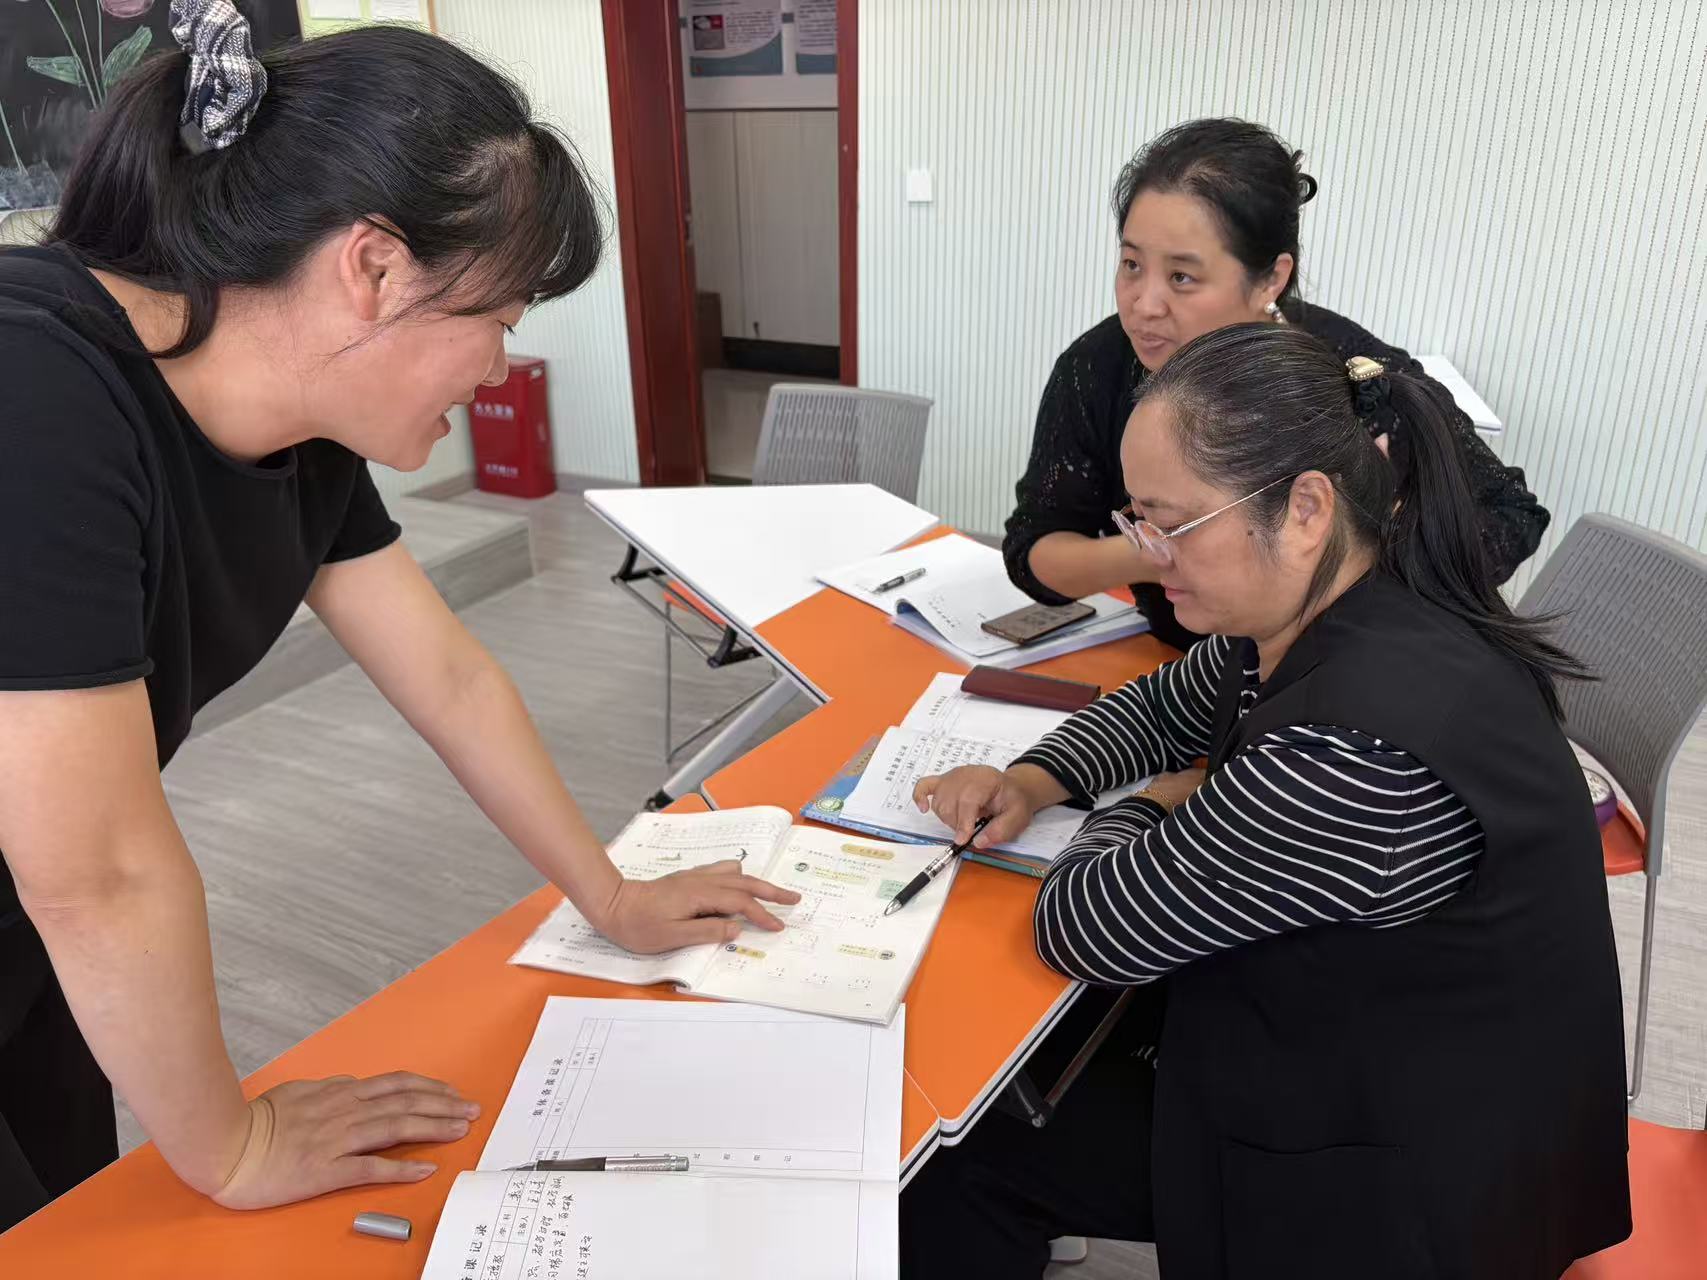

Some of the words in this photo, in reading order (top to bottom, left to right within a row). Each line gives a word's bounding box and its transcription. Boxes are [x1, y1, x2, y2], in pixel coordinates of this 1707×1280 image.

[532, 1058, 563, 1116] 集体备课记录
[517, 1215, 529, 1236] 主备人
